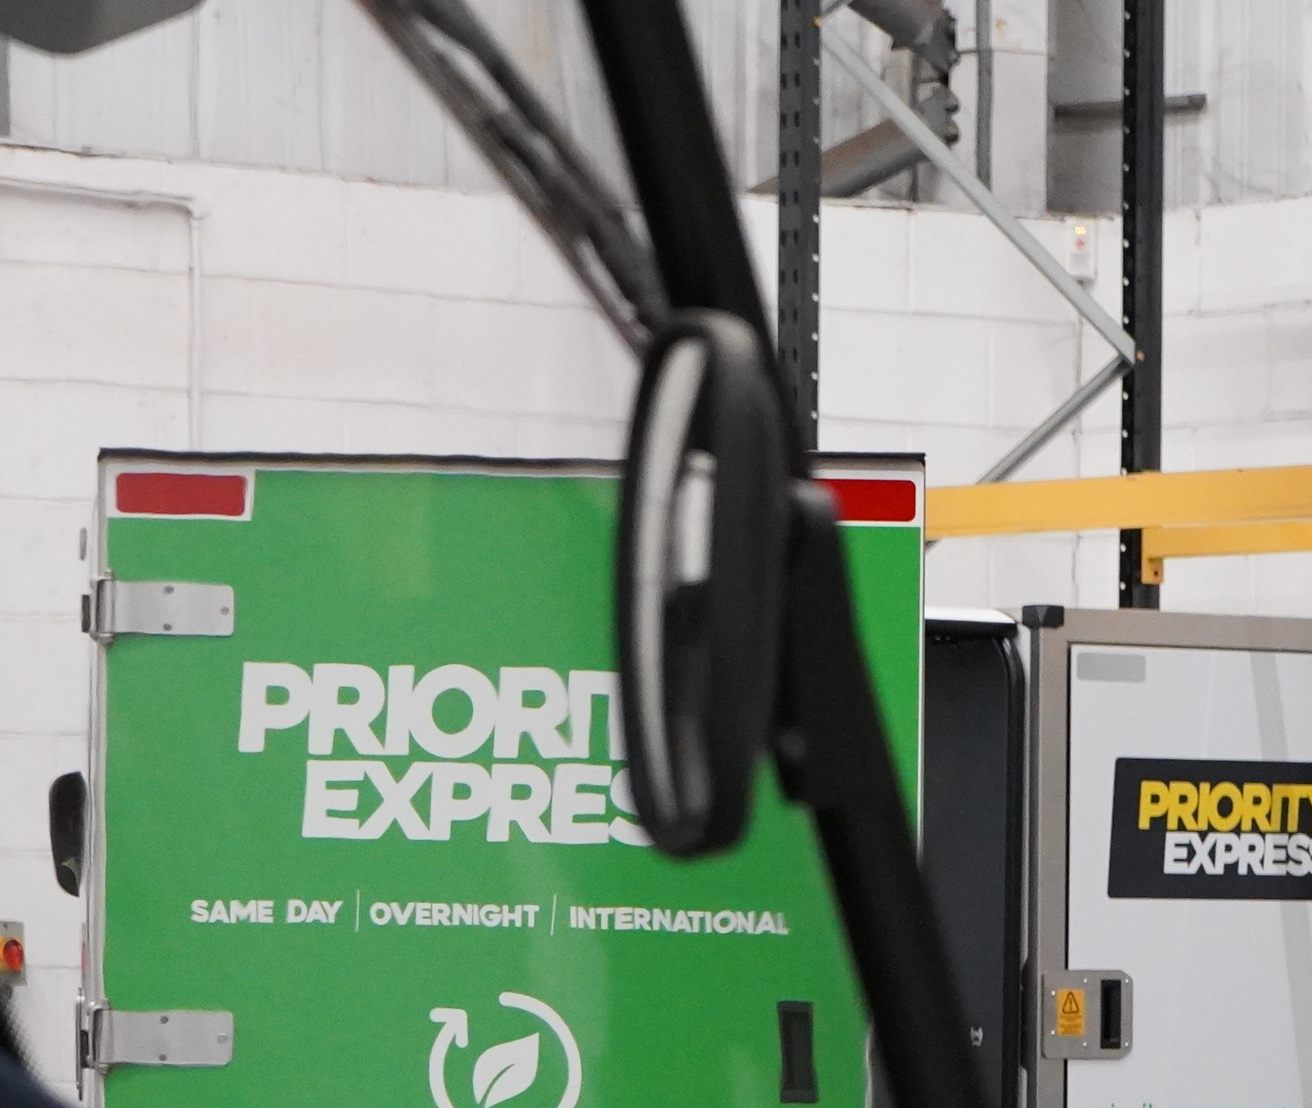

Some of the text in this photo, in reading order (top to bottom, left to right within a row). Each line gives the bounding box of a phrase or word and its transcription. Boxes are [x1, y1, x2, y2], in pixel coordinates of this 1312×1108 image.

[238, 661, 628, 760] PRIORIT
[301, 758, 656, 846] EXPRES
[191, 898, 790, 936] SAME DAY OVERNIGHT INTERNATIONAL
